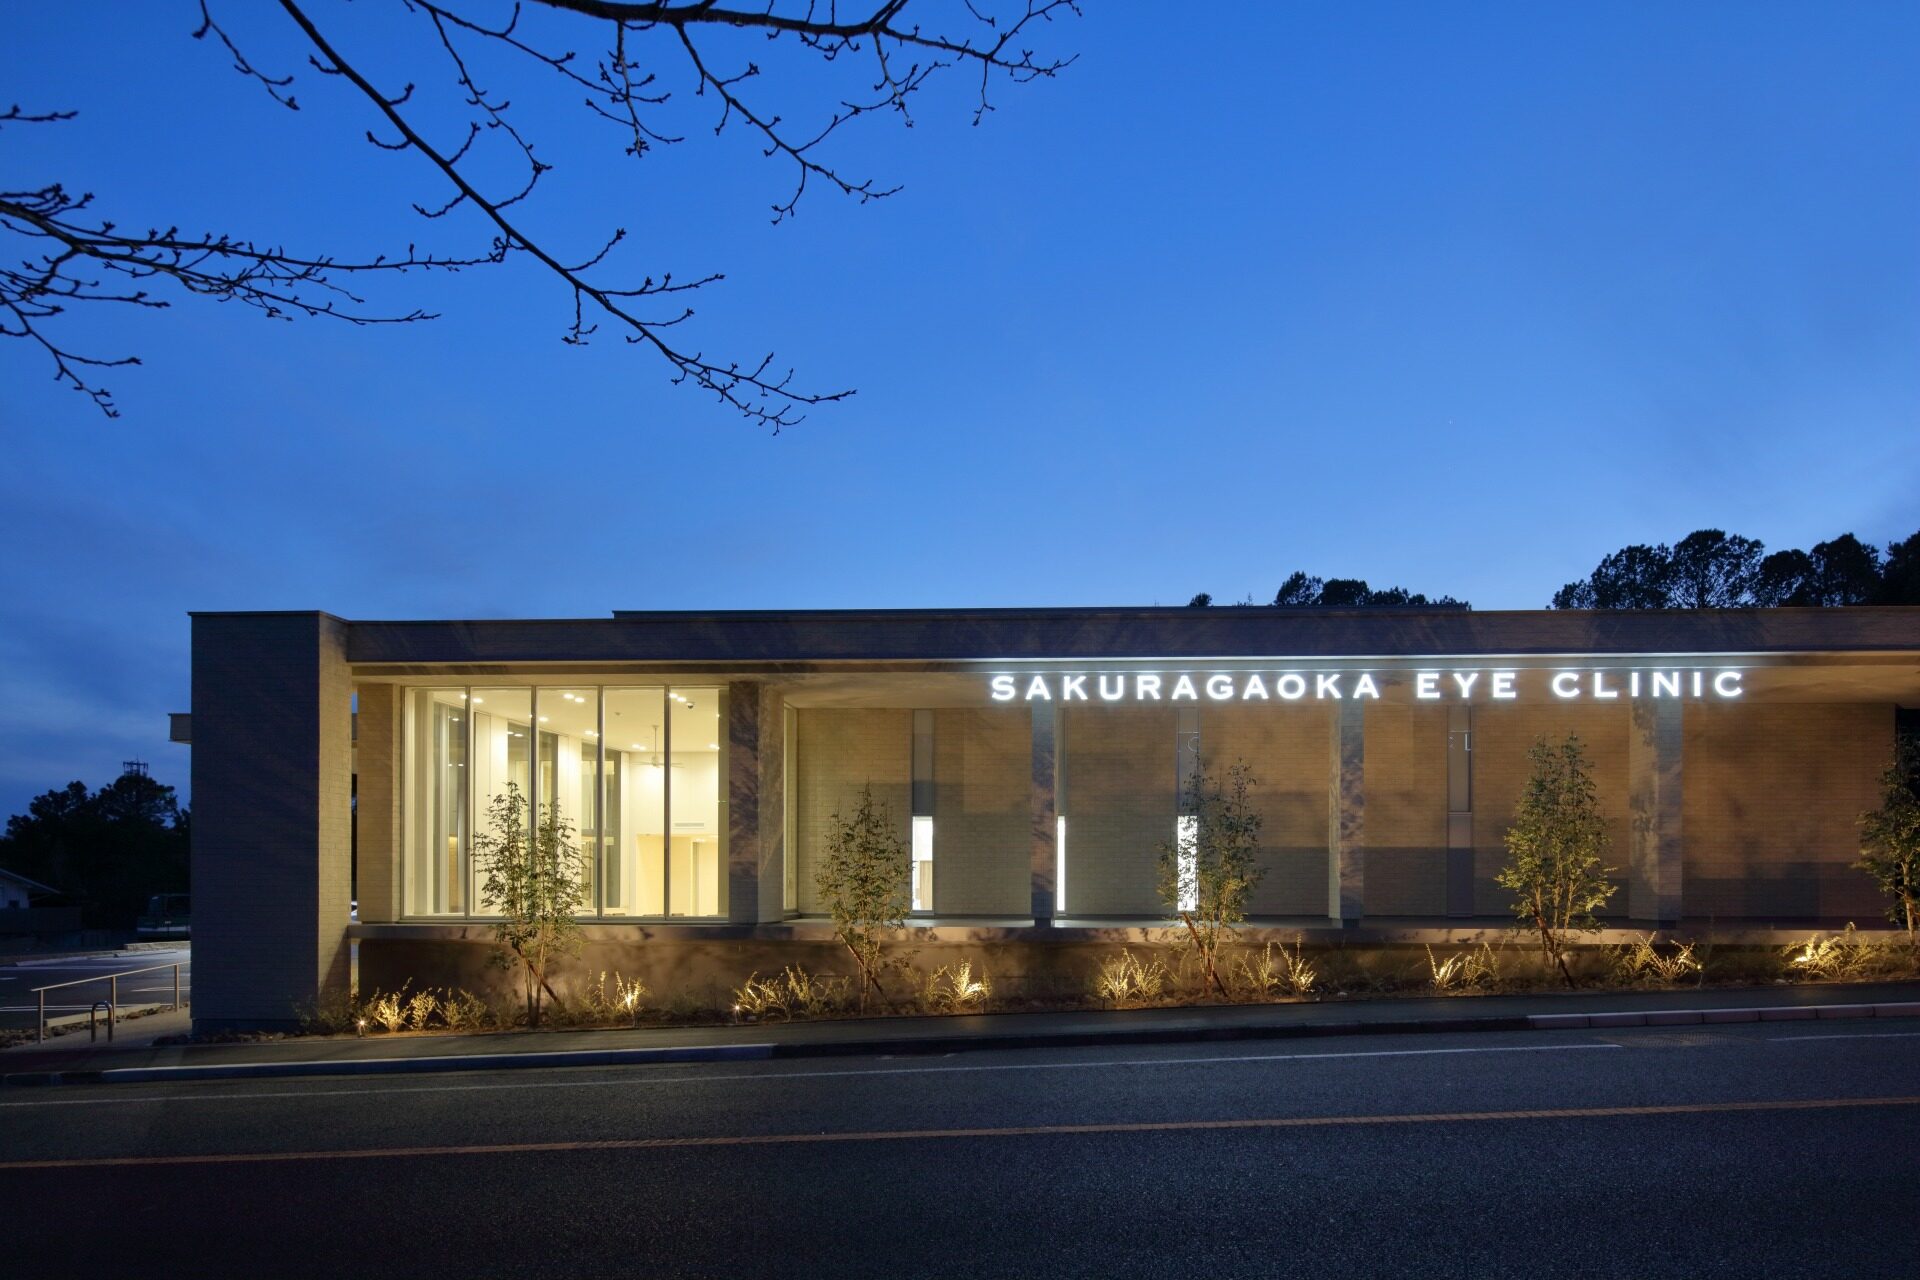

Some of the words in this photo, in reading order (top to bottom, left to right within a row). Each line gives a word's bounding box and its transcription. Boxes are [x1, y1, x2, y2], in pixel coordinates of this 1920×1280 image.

[991, 674, 1380, 700] SAKURAGAOKA
[1417, 672, 1517, 698] EYE
[1552, 671, 1742, 698] CLINIC
